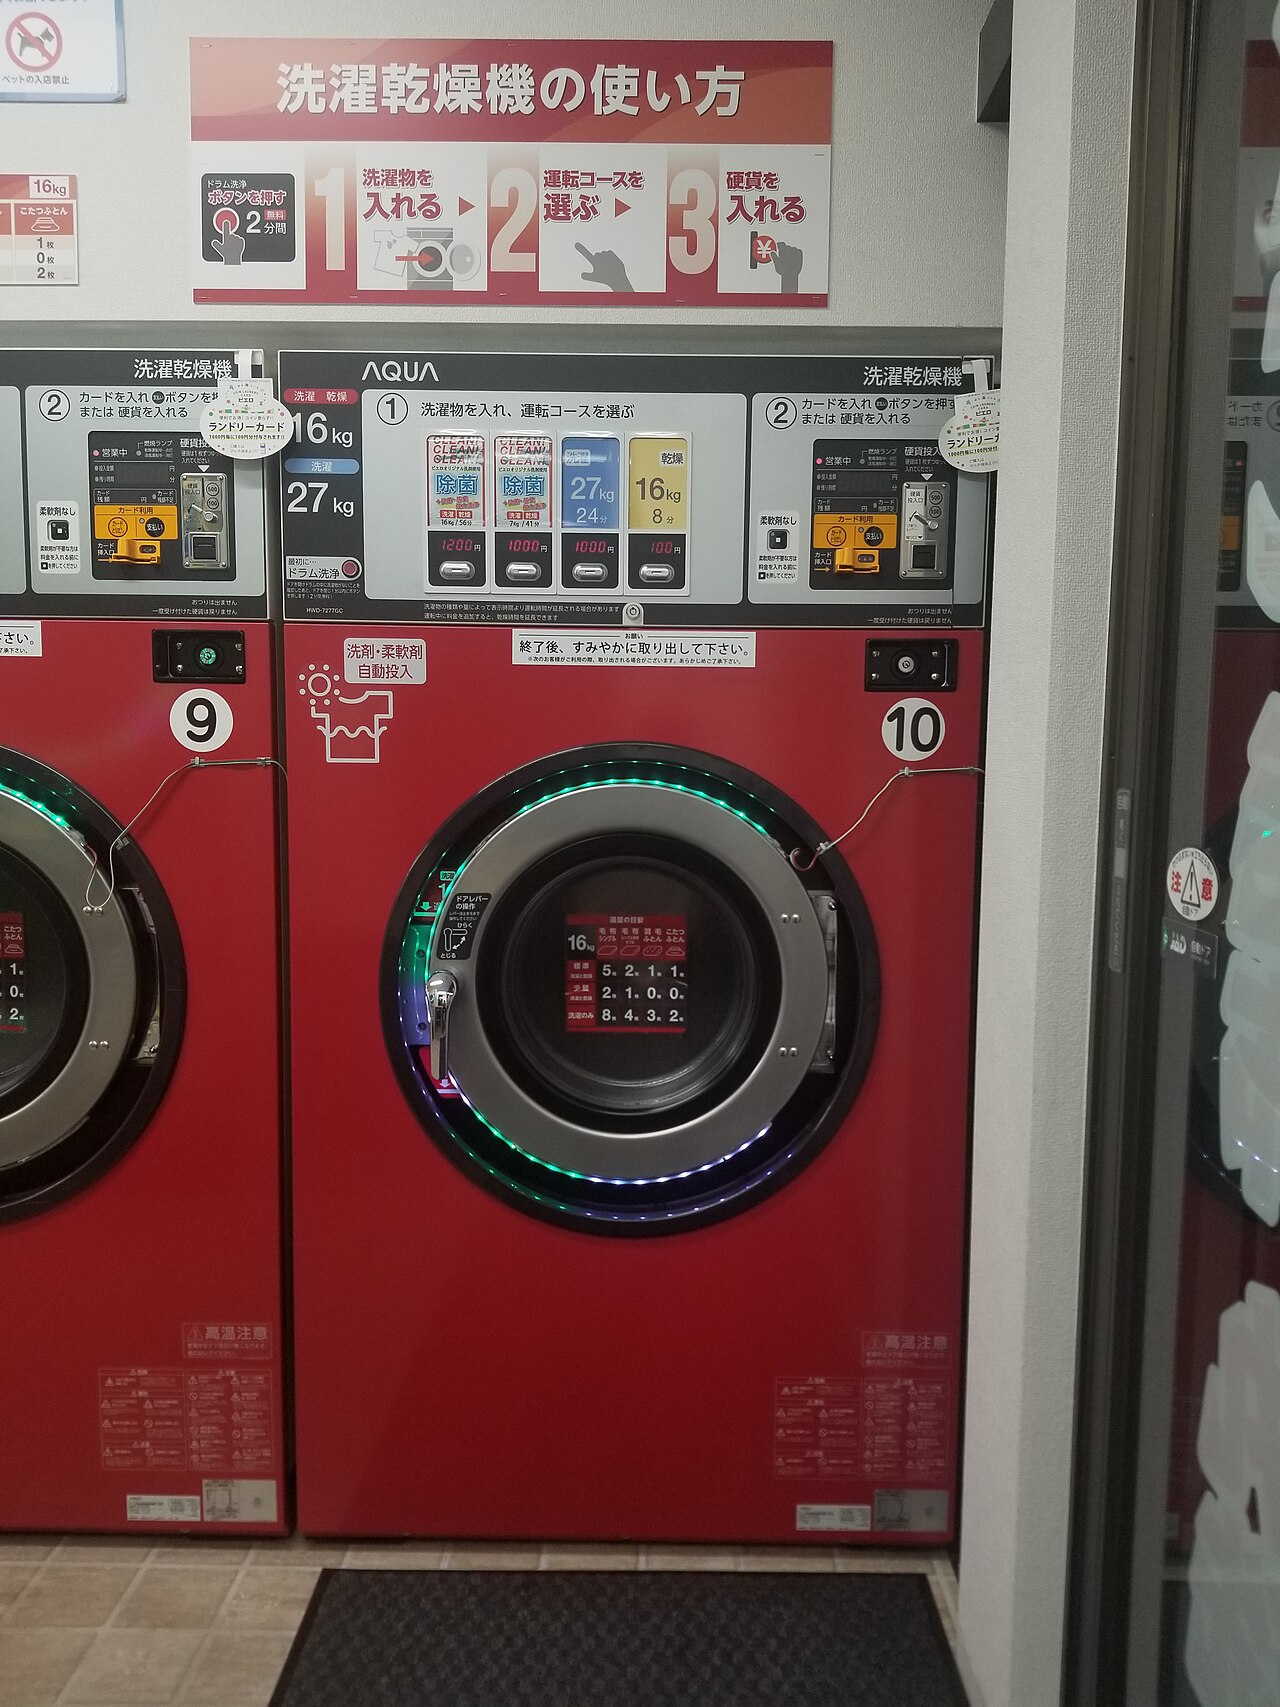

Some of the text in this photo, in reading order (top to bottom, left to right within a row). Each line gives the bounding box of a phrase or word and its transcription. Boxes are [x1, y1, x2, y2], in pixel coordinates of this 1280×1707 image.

[2, 74, 70, 86] ペットの入店禁止
[275, 63, 746, 118] 洗濯乾燥機の使い方
[207, 179, 247, 189] ドラム洗浄
[362, 168, 434, 189] 洗濯物を
[543, 169, 646, 190] 運転コースを
[726, 170, 781, 191] 硬貨を
[33, 179, 67, 197] 16kg
[208, 189, 287, 206] ボタンを押す
[19, 206, 68, 216] こたつふとん
[361, 191, 444, 222] 入れる
[543, 192, 602, 223] 選ぶ
[726, 194, 808, 224] 入れる
[246, 211, 287, 235] 2 分間
[266, 211, 284, 221] 無料
[313, 167, 346, 273] 1
[490, 167, 537, 274] 2
[668, 169, 716, 275] 3
[133, 359, 233, 380] 洗濯乾燥機
[361, 361, 439, 382] AQUA
[863, 366, 963, 388] 洗濯乾燥機
[79, 391, 149, 403] カードを入れ
[294, 391, 348, 402] 洗濯 乾燥
[801, 398, 872, 410] カードを入れ
[79, 406, 188, 419] または 硬貨を入れる
[420, 403, 635, 419] 洗濯物を入れ、運転コースを選ぶ
[208, 422, 285, 433] ランドリーカード
[801, 413, 911, 426] または 硬貨を入れる
[101, 448, 128, 458] 営業中
[433, 445, 479, 455] CLEAN!
[500, 446, 546, 456] CLEAN!
[311, 461, 332, 472] 洗濯
[661, 452, 684, 465] 乾燥
[825, 456, 852, 466] 営業中
[436, 474, 478, 495] 除菌
[503, 475, 545, 497] 除菌
[570, 476, 615, 503] 27kg
[636, 478, 681, 503] 16kg
[287, 482, 354, 517] 27kg
[39, 506, 76, 517] 柔軟剤なし
[576, 507, 608, 524] 24分
[759, 516, 797, 526] 柔軟剤なし
[865, 532, 882, 541] 支払い
[289, 568, 340, 579] ドラム洗浄
[347, 644, 423, 660] 洗剤・柔軟剤
[519, 640, 749, 656] 終了後、すみやかに取り出して下さい。
[358, 663, 414, 680] 自動投入
[186, 697, 217, 743] 9
[886, 706, 941, 753] 10
[455, 902, 476, 910] の操作
[456, 895, 489, 903] ドアレバー
[567, 934, 595, 952] 16kg
[643, 935, 662, 943] ふとん
[205, 1326, 268, 1341] 高温注意
[885, 1335, 947, 1350] 高温注意
